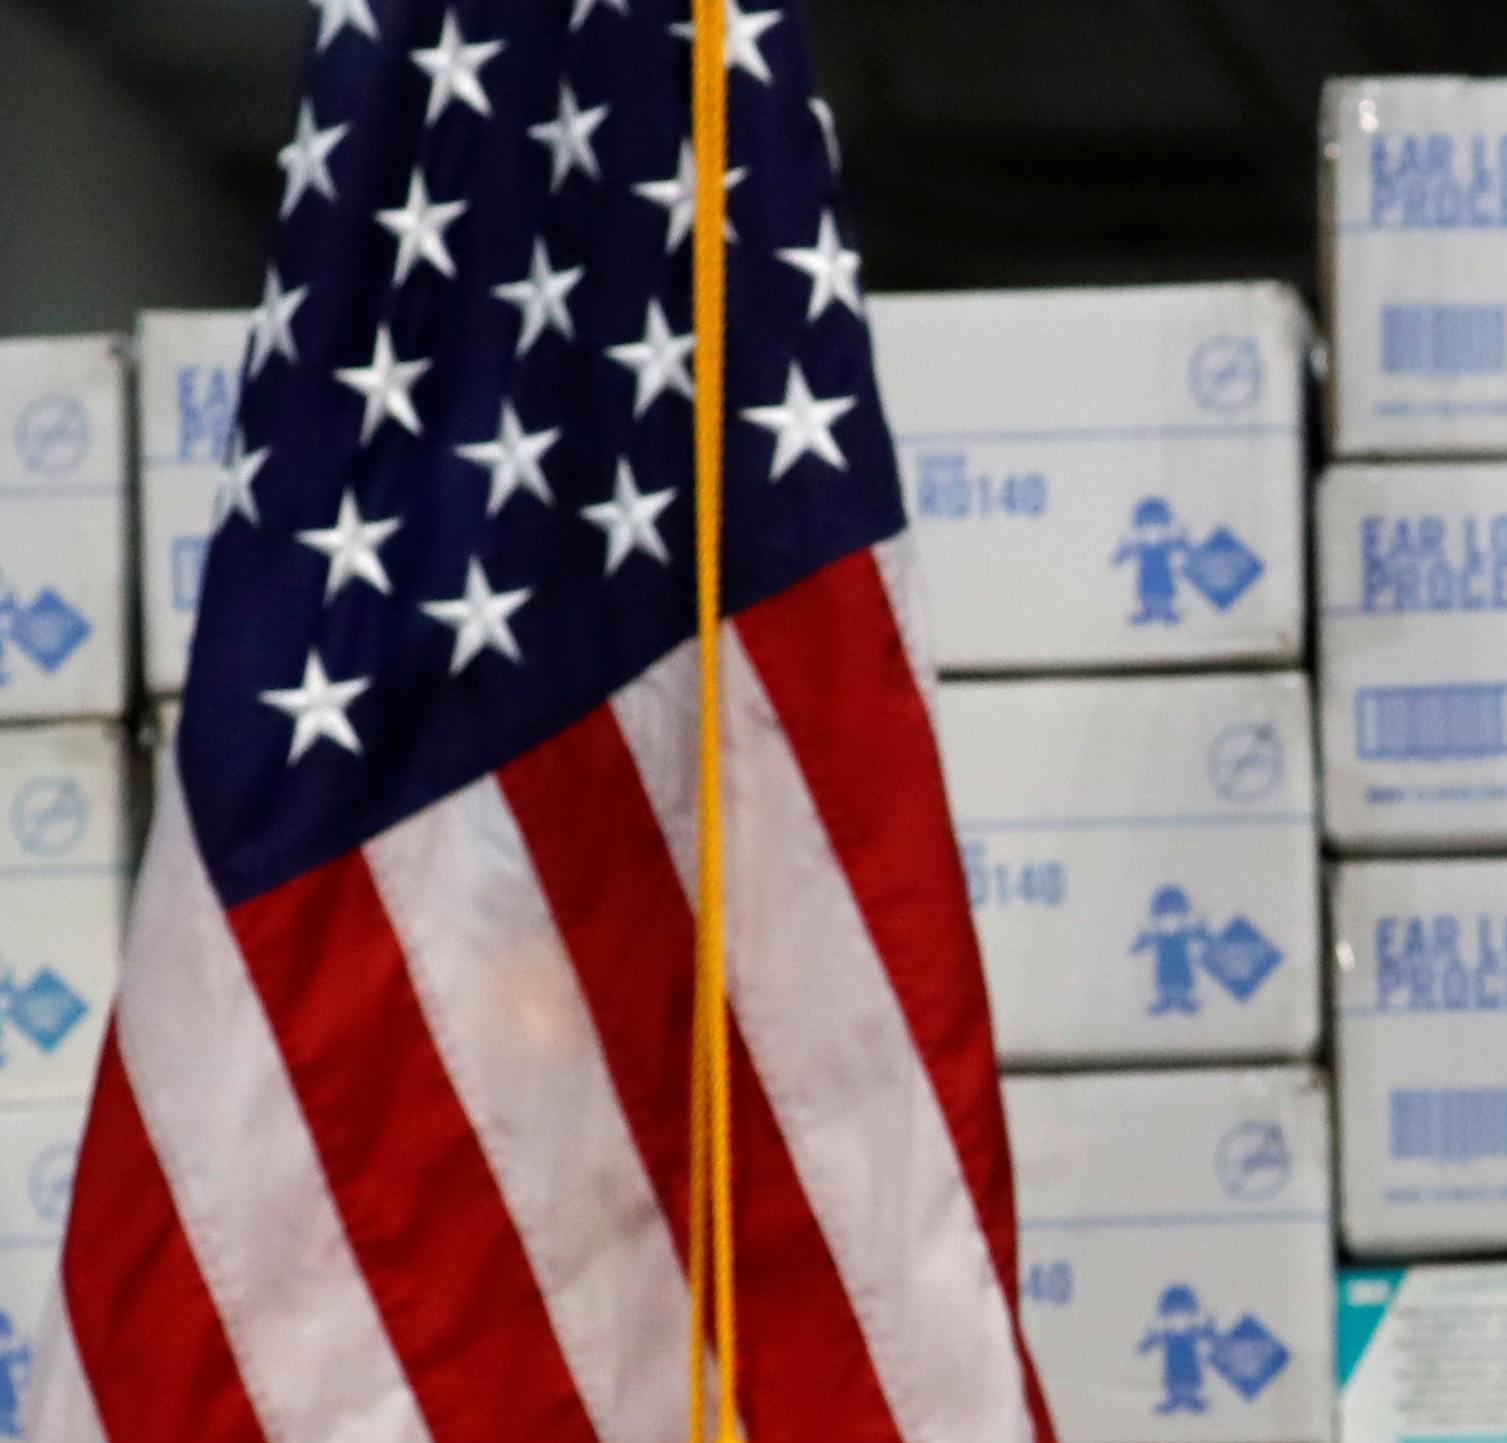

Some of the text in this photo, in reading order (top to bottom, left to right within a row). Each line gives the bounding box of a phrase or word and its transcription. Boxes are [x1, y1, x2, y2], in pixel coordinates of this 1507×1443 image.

[1370, 132, 1454, 177] EAR
[1361, 514, 1447, 560] EAR
[1375, 914, 1459, 960] EAR
